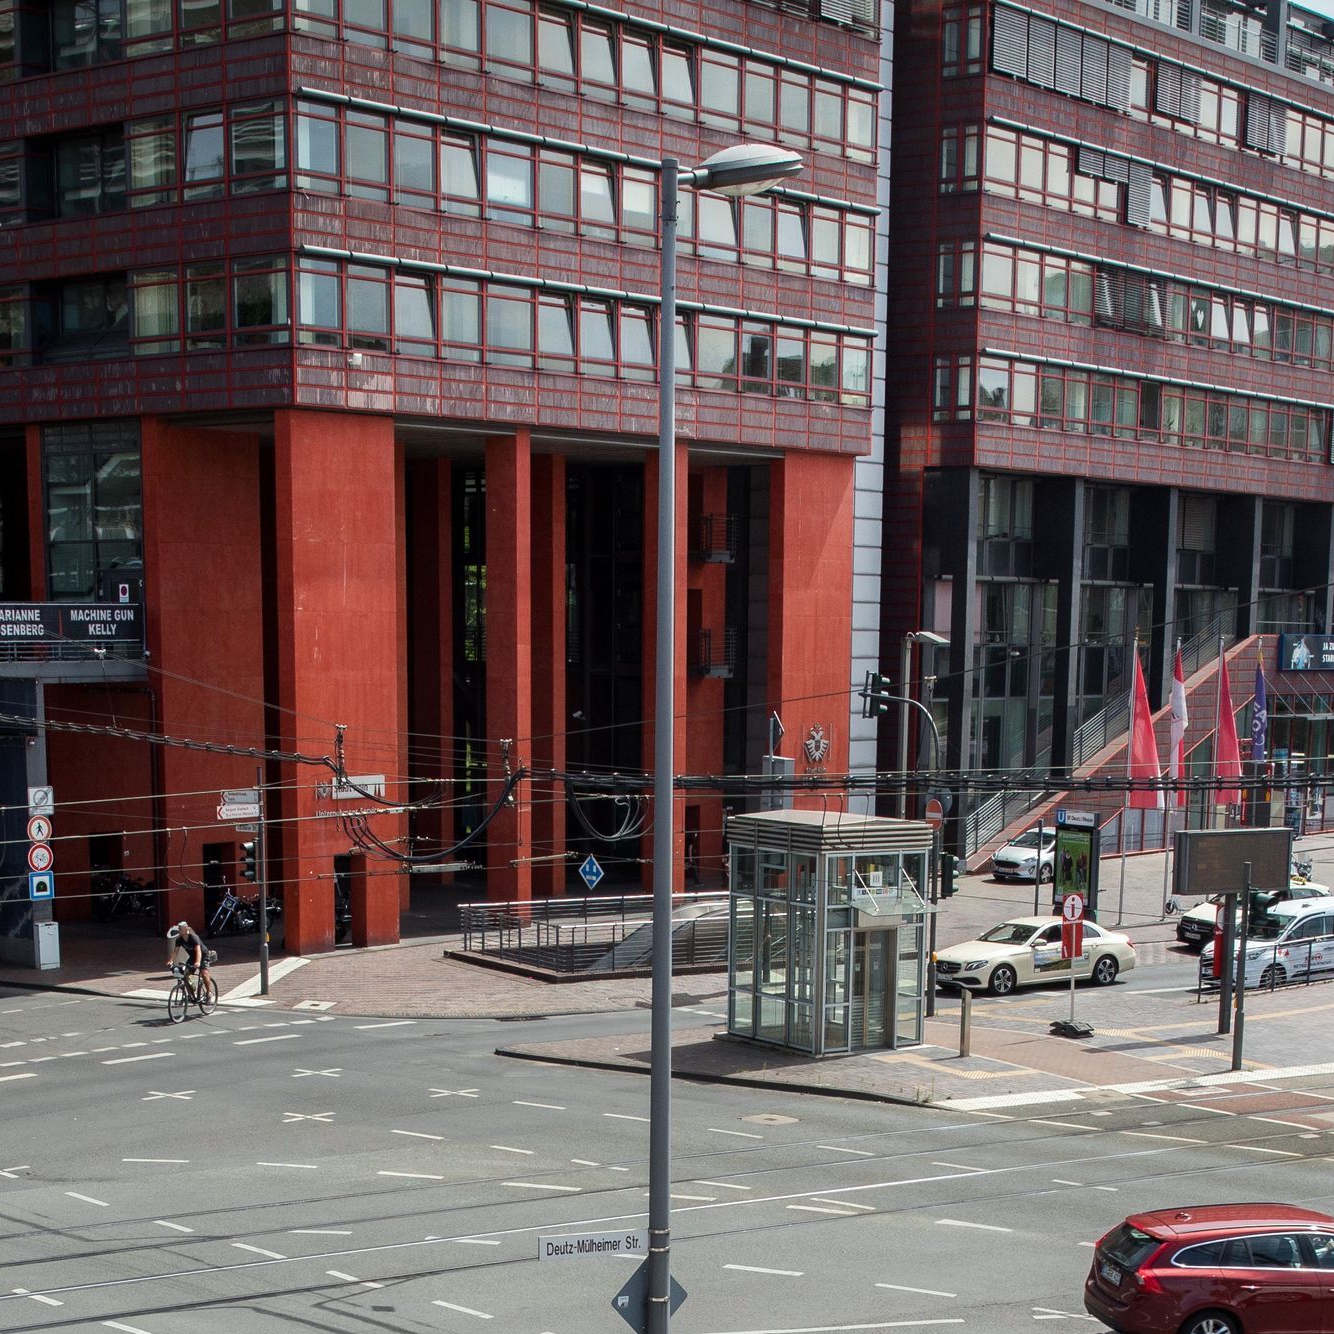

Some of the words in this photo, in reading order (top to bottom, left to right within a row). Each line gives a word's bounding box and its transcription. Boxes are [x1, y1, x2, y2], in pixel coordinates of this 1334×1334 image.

[70, 609, 112, 621] MACHINE
[113, 609, 134, 620] GUN
[88, 623, 117, 635] KELLY
[546, 1238, 622, 1256] Deutz-Mülheimer
[625, 1236, 641, 1250] Str.
